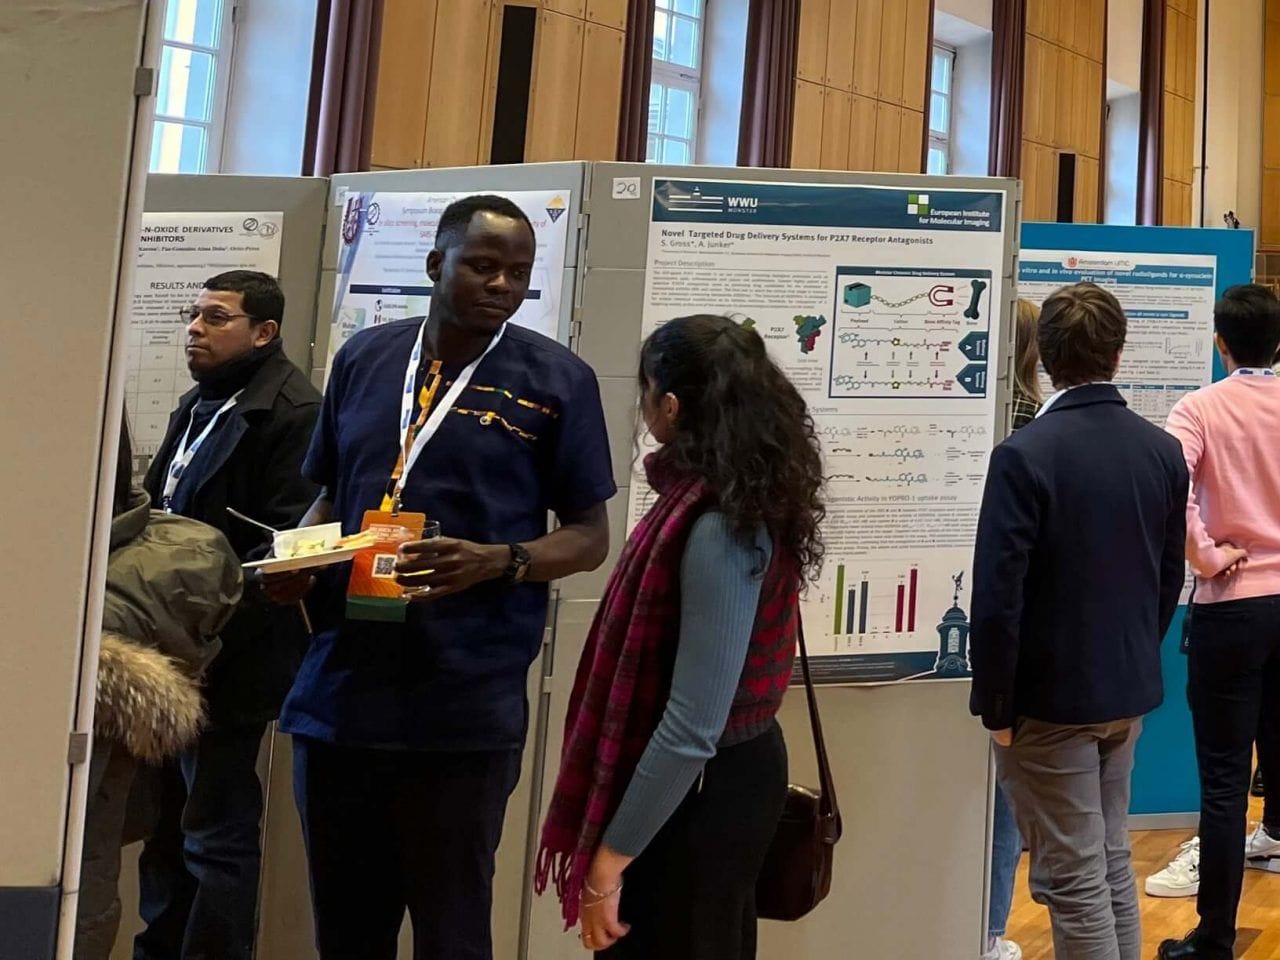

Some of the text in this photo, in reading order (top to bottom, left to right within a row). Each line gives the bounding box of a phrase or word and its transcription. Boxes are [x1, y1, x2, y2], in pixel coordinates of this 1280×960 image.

[728, 197, 758, 207] WWU
[930, 209, 990, 218] European Institute
[930, 217, 963, 225] Molecular
[964, 218, 990, 227] Imaging
[140, 235, 185, 243] NHIBITORS
[661, 229, 685, 237] Novel
[689, 230, 725, 239] Targeted
[726, 231, 745, 240] Drug
[747, 232, 779, 241] Delivery
[781, 233, 815, 241] Systems
[817, 233, 828, 241] for
[851, 235, 887, 244] Receptor
[888, 236, 934, 245] Antagonists
[150, 282, 205, 290] RESULTS AND
